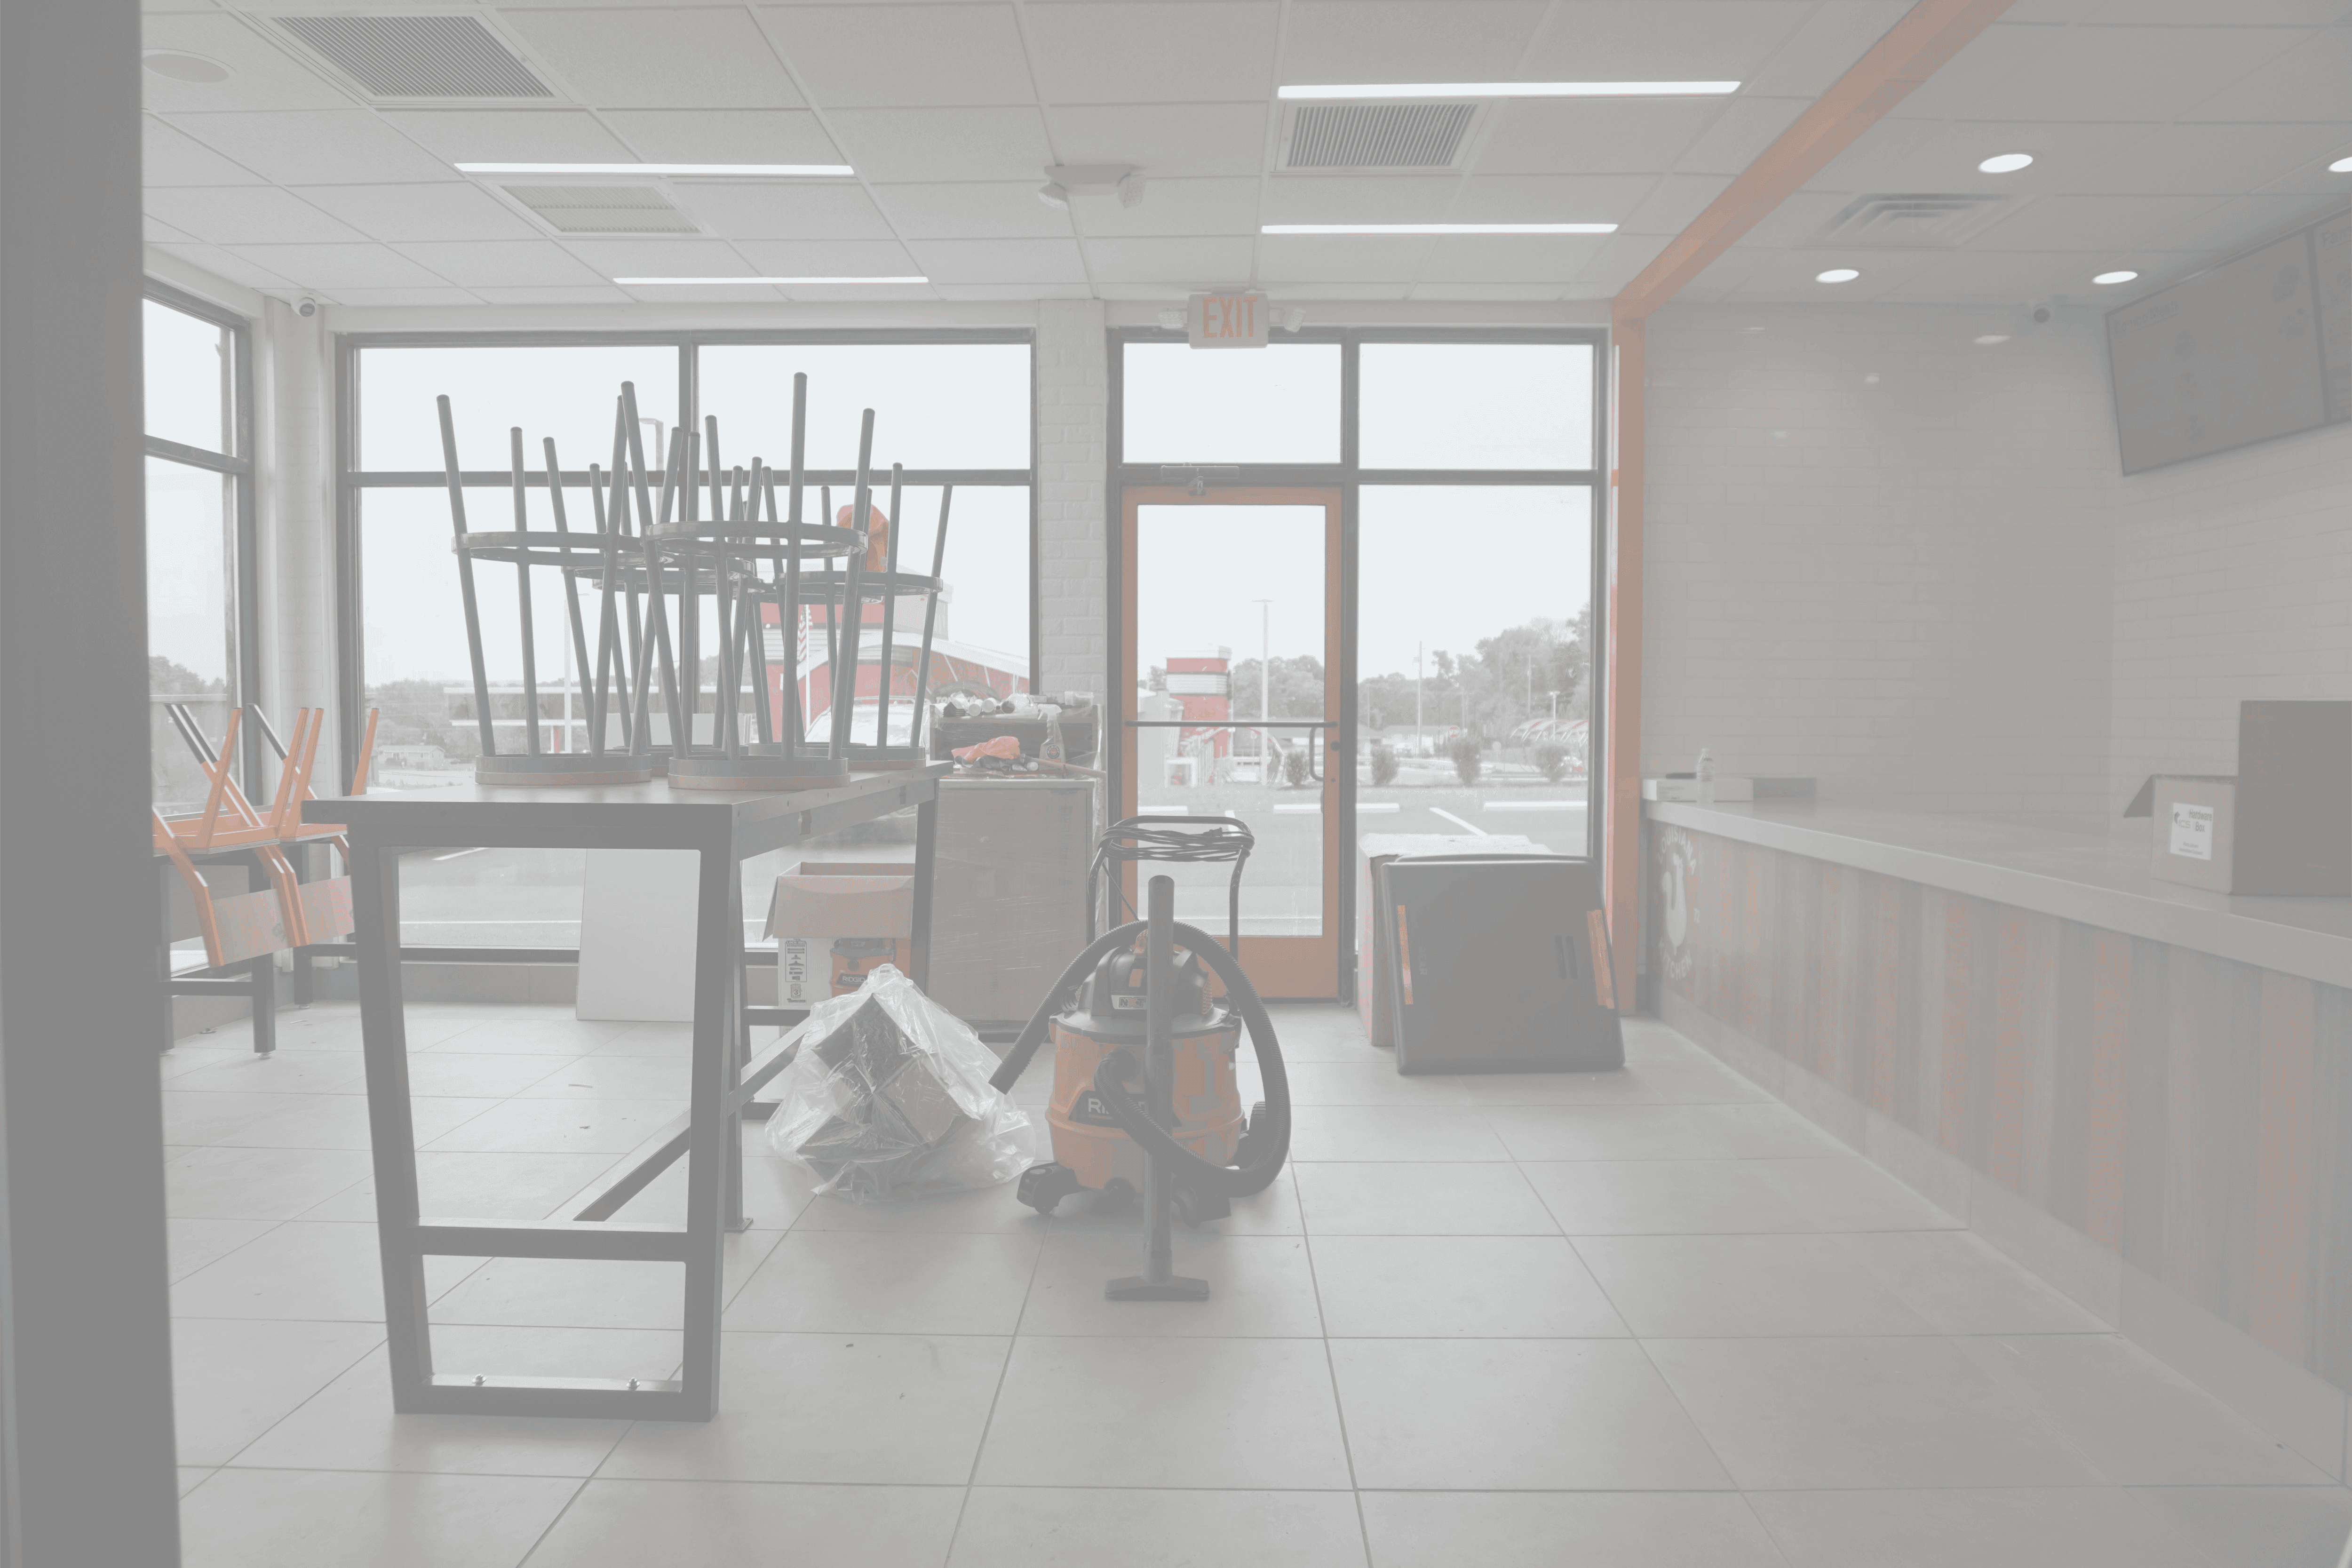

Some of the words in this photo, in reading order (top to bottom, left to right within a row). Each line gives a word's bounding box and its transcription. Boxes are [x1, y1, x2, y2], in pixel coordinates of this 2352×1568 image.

[1202, 295, 1258, 338] EXIT
[2189, 808, 2213, 821] Hardware
[2195, 821, 2205, 833] Box
[1657, 826, 1697, 876] LOUISIANA
[1658, 936, 1692, 980] KITCHEN
[1119, 997, 1146, 1008] NXT
